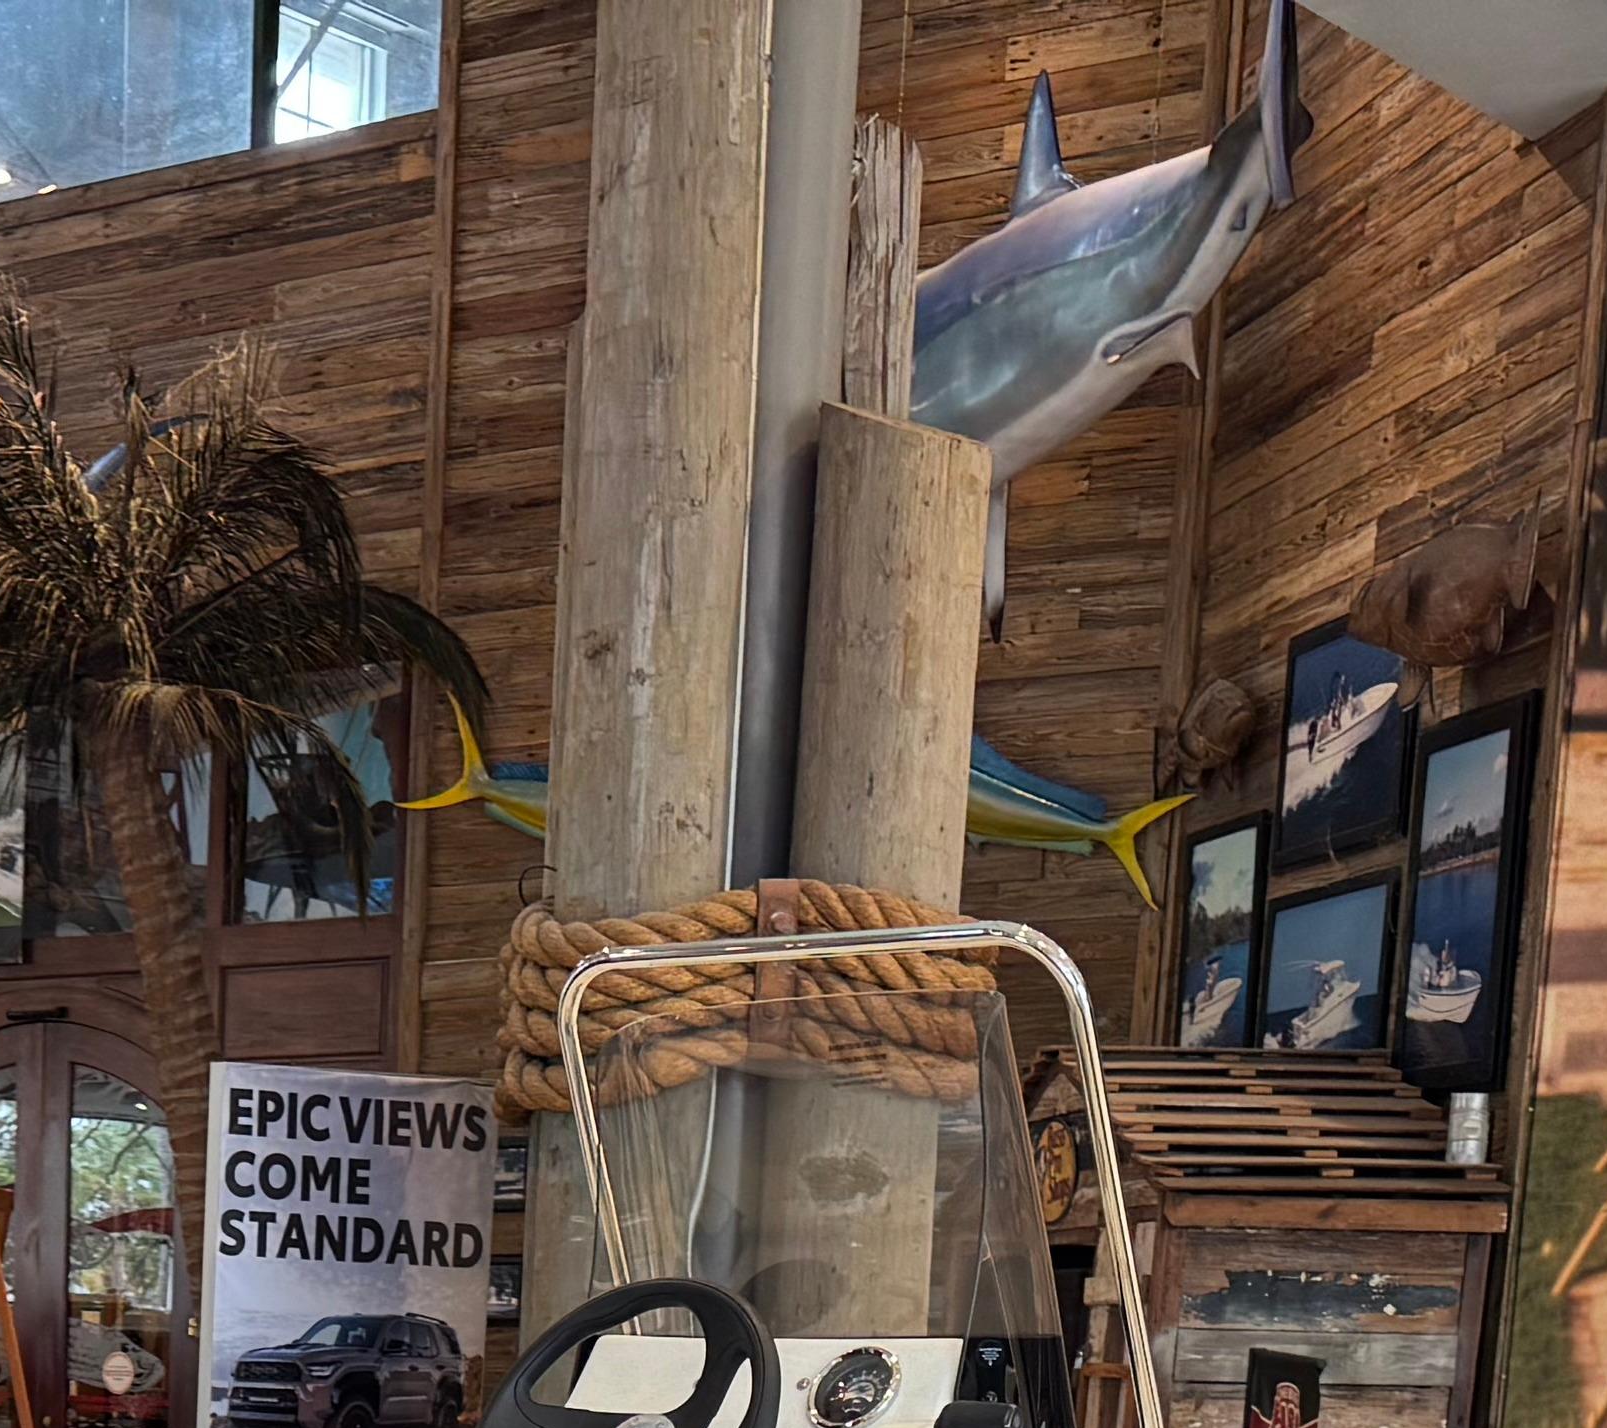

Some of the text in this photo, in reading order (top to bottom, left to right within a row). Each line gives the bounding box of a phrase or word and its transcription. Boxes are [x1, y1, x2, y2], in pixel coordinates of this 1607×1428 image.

[228, 1087, 488, 1152] EPIC VIEWS
[224, 1149, 372, 1205] COME
[218, 1208, 484, 1269] STANDARD
